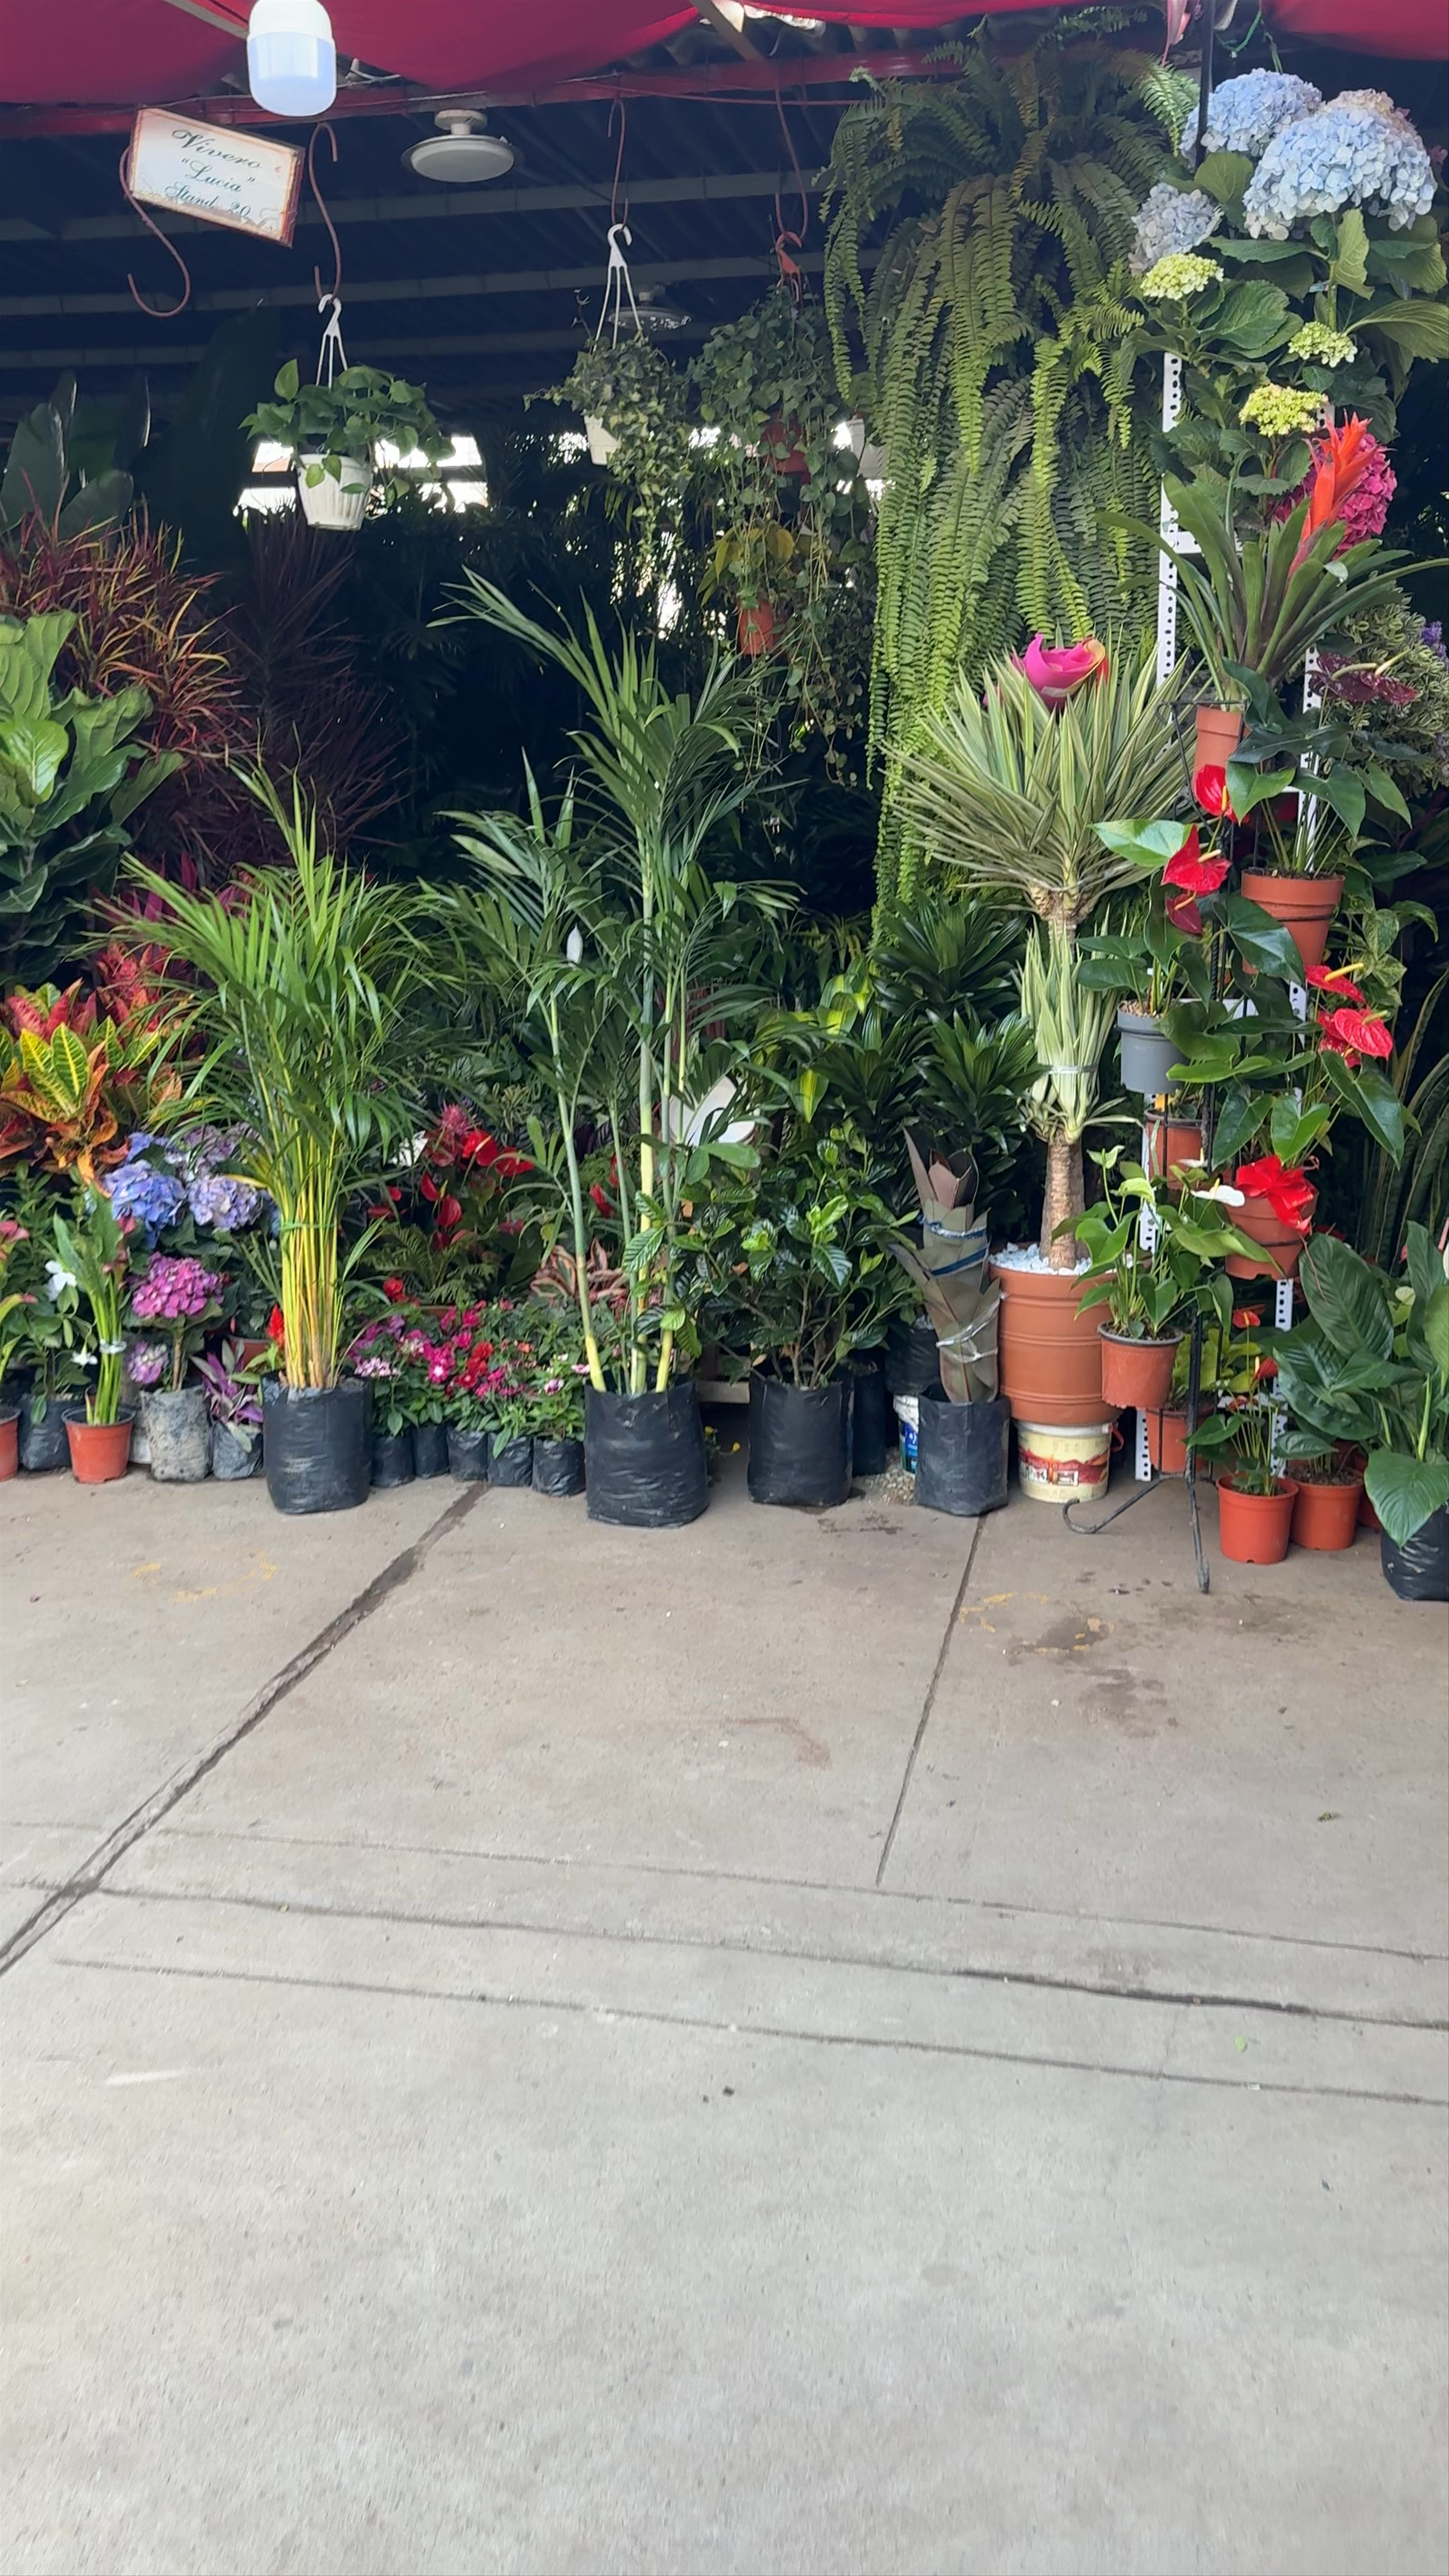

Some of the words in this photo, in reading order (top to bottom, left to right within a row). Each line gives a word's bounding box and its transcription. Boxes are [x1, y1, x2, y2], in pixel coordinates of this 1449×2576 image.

[172, 129, 262, 168] Vivero
[165, 181, 219, 209] Stand
[227, 201, 252, 218] 20
